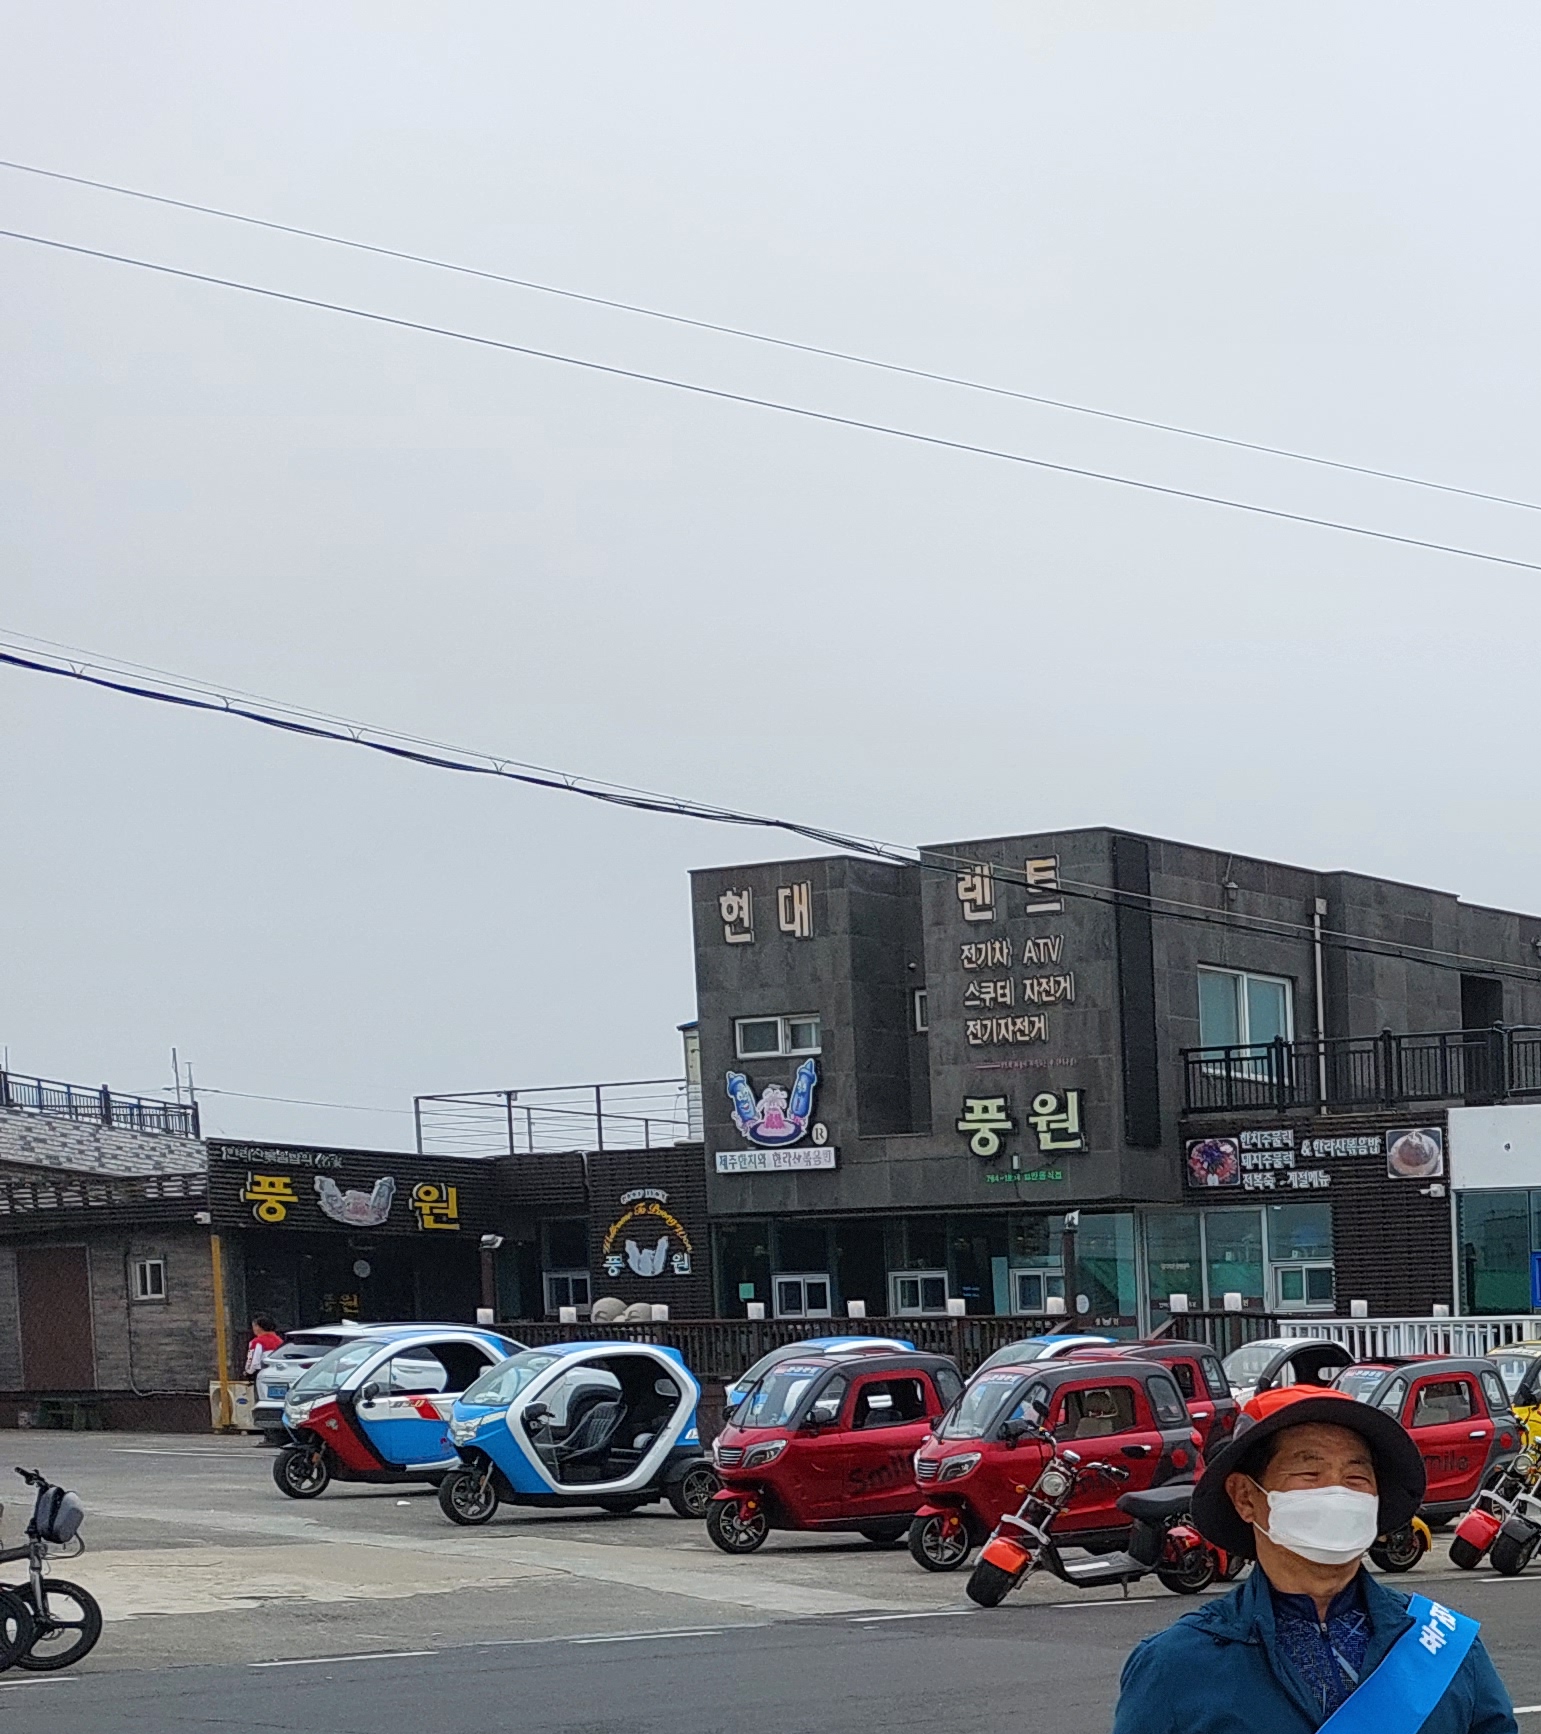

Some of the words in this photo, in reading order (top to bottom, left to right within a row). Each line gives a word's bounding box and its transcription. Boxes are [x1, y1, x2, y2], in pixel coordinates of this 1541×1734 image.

[961, 939, 1012, 969] 전기차
[1023, 935, 1064, 965] ATV
[964, 978, 1015, 1007] 스쿠터
[1023, 972, 1074, 1002] 자전거
[966, 1012, 1049, 1045] 전기자전거
